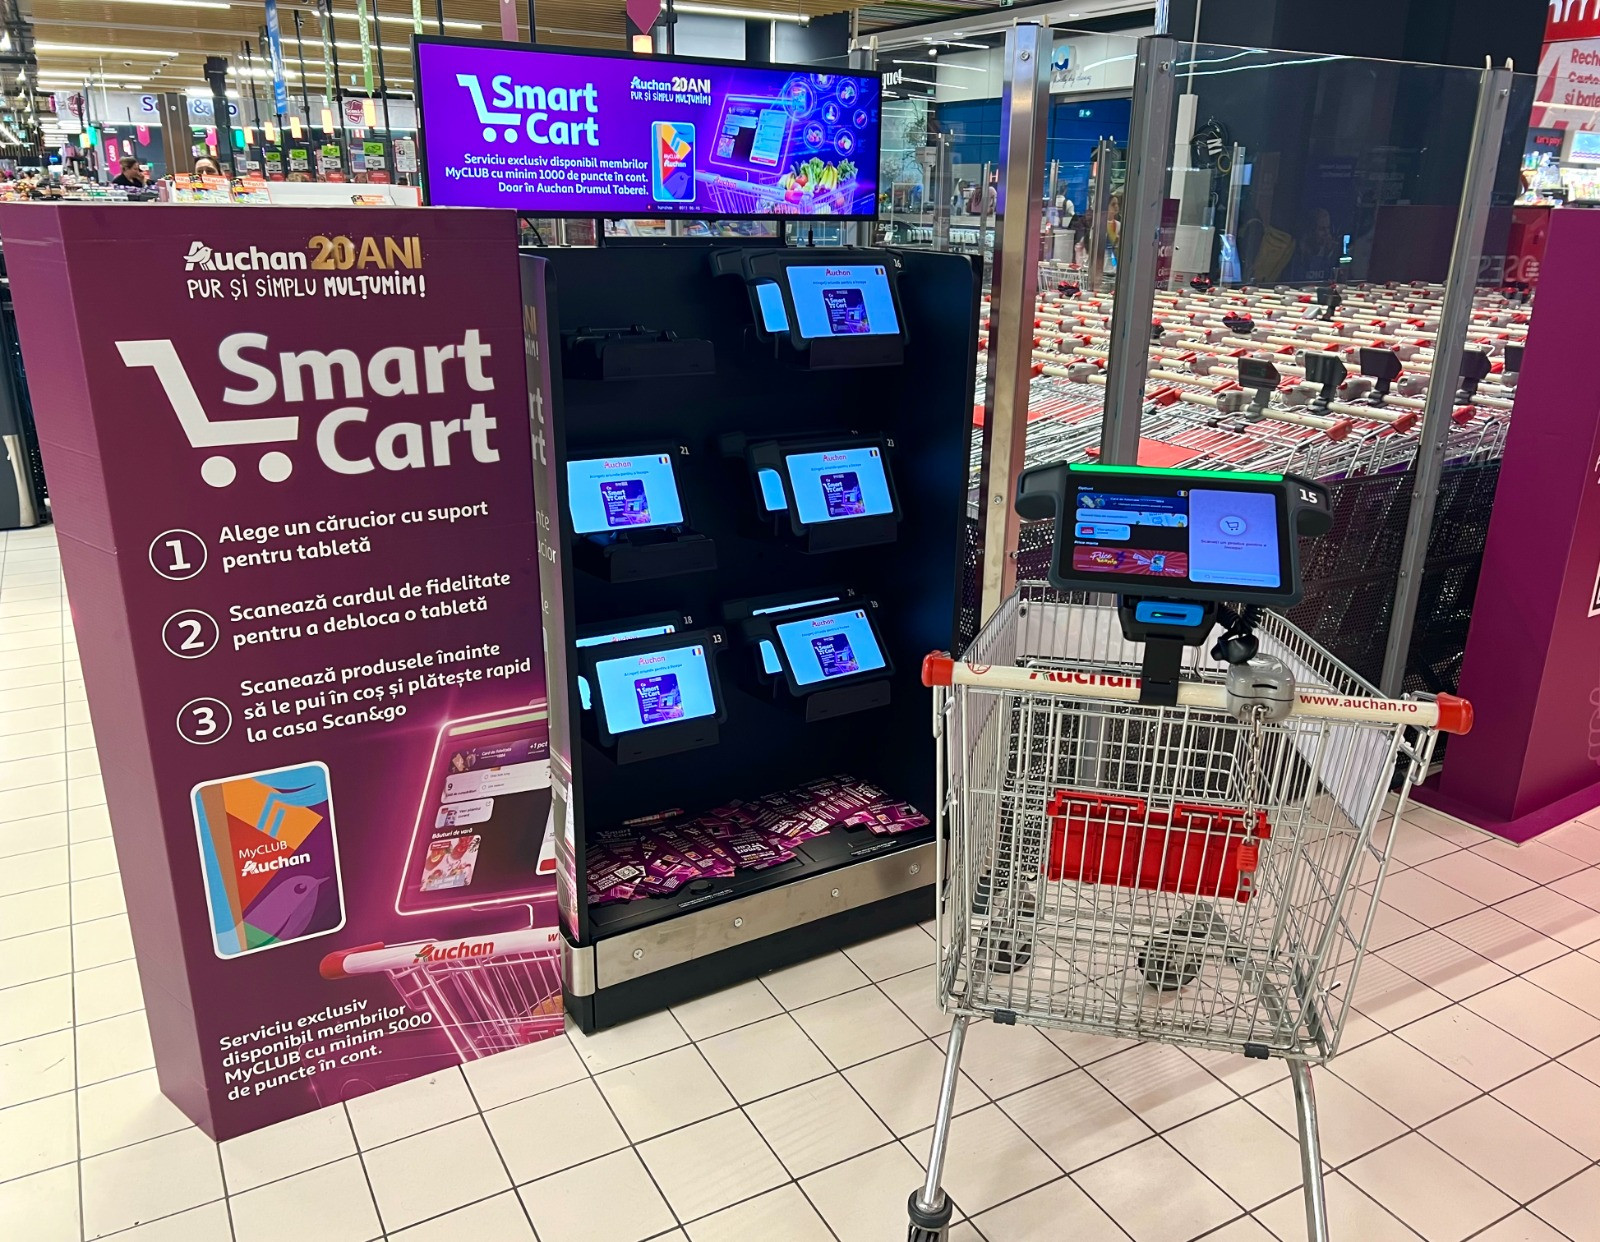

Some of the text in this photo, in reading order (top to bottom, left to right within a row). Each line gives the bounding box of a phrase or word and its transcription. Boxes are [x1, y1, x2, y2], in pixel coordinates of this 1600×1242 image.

[492, 75, 598, 112] Smart
[630, 76, 671, 91] Auchan
[631, 91, 643, 100] PUR
[526, 113, 600, 147] Cart
[445, 167, 489, 180] MyCLUB
[491, 170, 503, 179] cu
[505, 168, 537, 179] minim
[539, 169, 565, 180] 1000
[567, 170, 579, 180] de
[580, 171, 612, 184] puncte
[625, 172, 649, 183] cont.
[464, 153, 648, 170] Serviciu exclusiv disponibil membrilor
[664, 160, 687, 168] Auchan
[498, 182, 523, 193] Doar
[536, 183, 574, 193] Auchan
[575, 183, 611, 195] Drumul
[612, 184, 649, 195] Taberei.
[184, 241, 307, 271] Auchan
[188, 278, 224, 299] PUR
[218, 329, 495, 406] Smart
[316, 403, 500, 475] Cart
[680, 446, 690, 455] 21
[1300, 489, 1319, 504] 15
[219, 501, 489, 546] Alege un cărucior cu suport
[165, 540, 191, 571] 1
[222, 536, 372, 573] pentru tabletă
[229, 570, 511, 622] Scanează cardul de fidelitate
[177, 619, 205, 651] 2
[233, 596, 488, 651] pentru a debloca o tabletă
[712, 634, 722, 643] 13
[240, 642, 501, 697] Scanează produsele înainte
[243, 699, 267, 721] să
[271, 696, 291, 716] le
[295, 691, 326, 716] pui
[329, 687, 349, 706] în
[486, 657, 531, 682] rapid
[1299, 693, 1418, 713] www.auchan.ro
[192, 707, 217, 736] 3
[246, 703, 407, 744] la casa Scan&go
[447, 783, 453, 791] 9
[239, 840, 288, 859] MyCLUB
[241, 852, 311, 877] Auchan
[413, 941, 495, 964] Auchan
[219, 998, 369, 1051] Serviciu exclusiv
[222, 1004, 407, 1068] disponibil membrilor
[224, 1012, 433, 1087] MyCLUB cu minim 5000
[227, 1048, 383, 1102] de puncte în cont.
